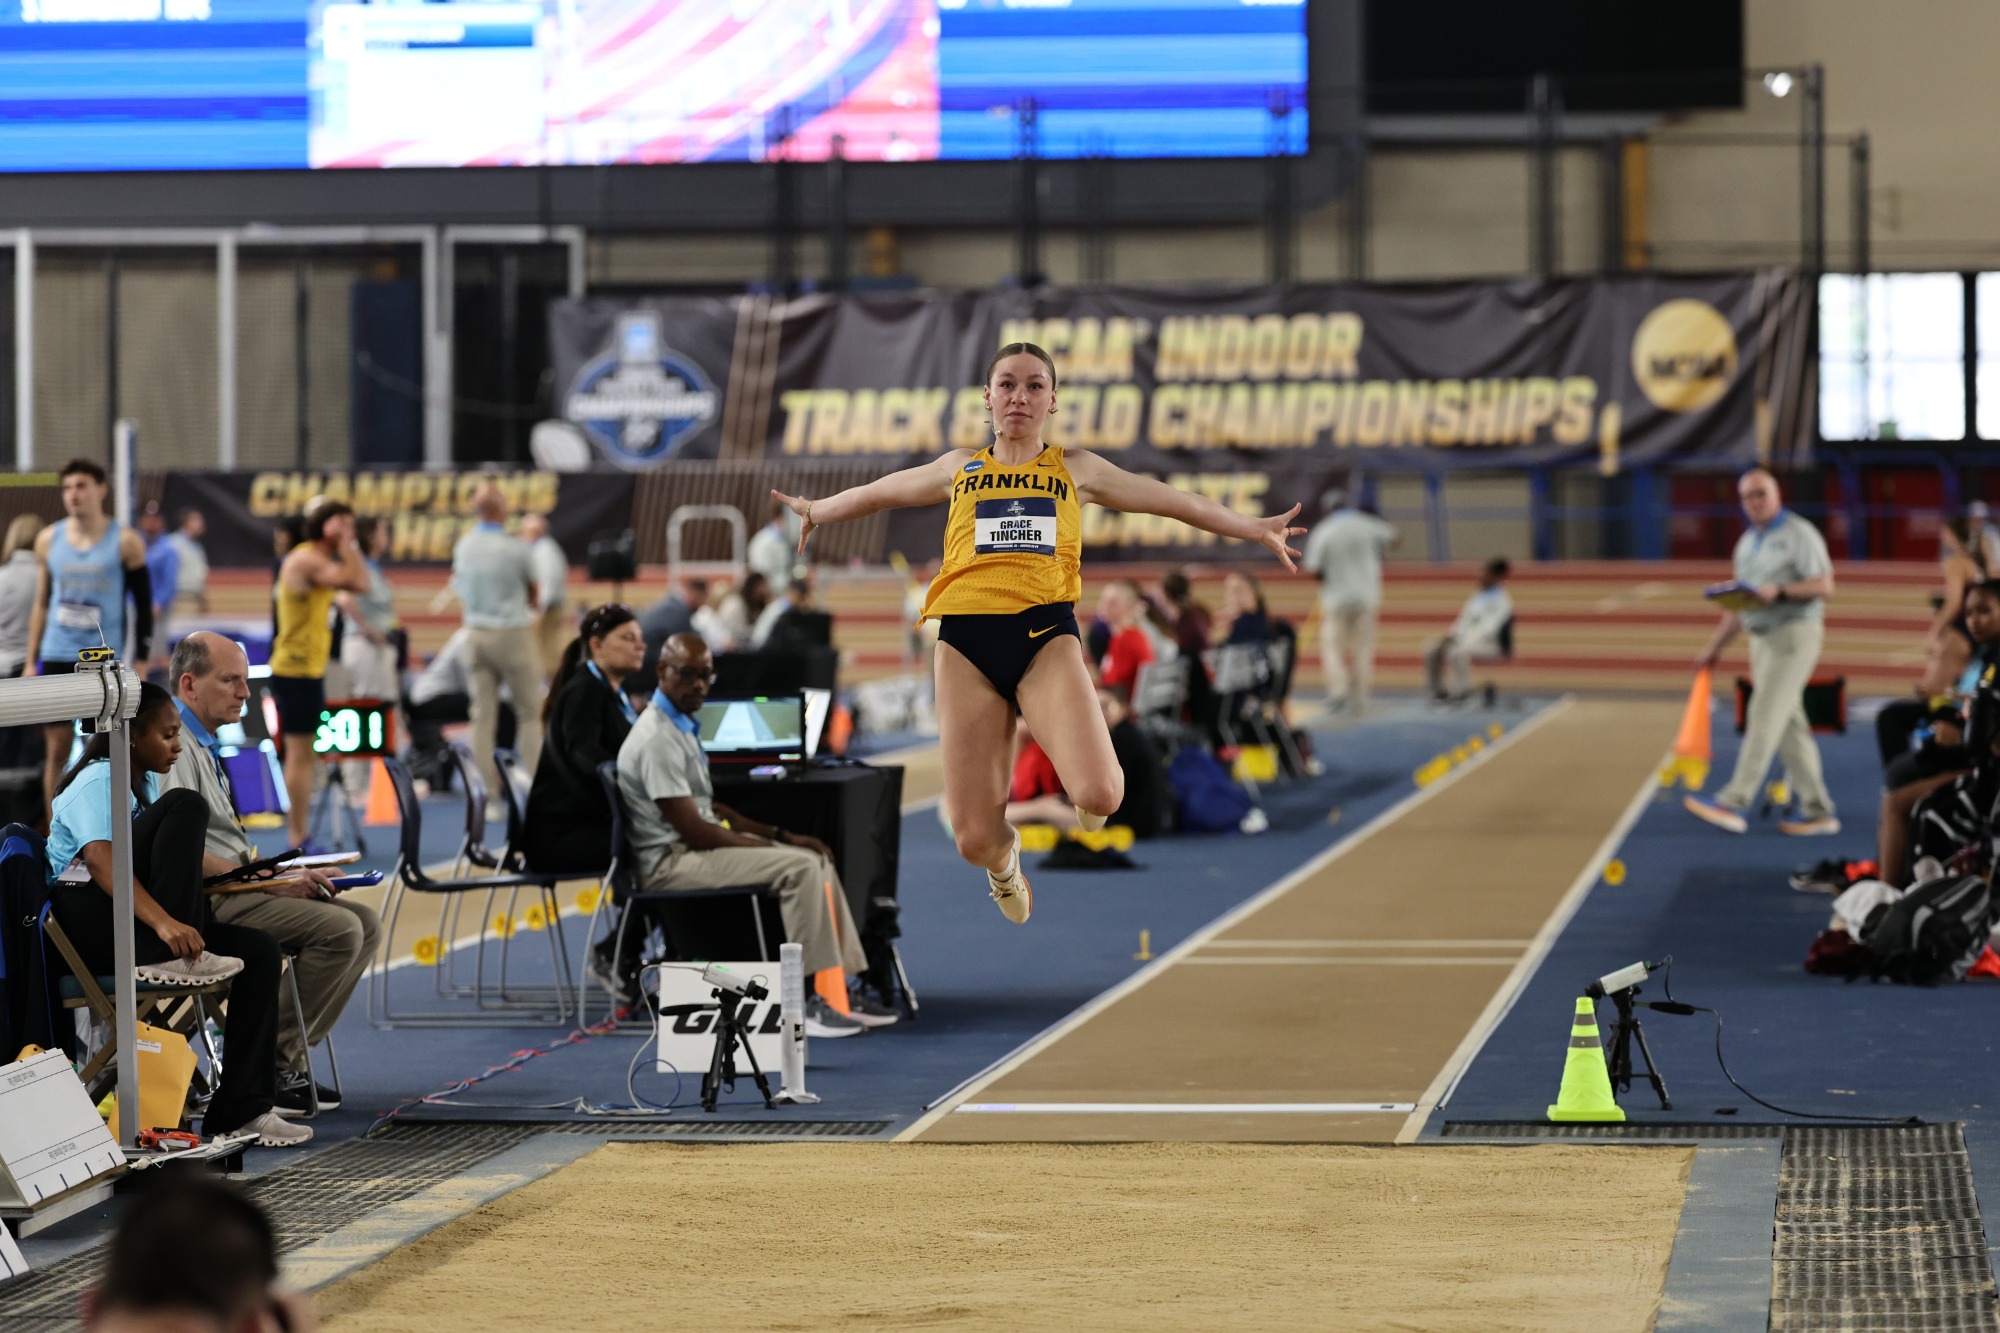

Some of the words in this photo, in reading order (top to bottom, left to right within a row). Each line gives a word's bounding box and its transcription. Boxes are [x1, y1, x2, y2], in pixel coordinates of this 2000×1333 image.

[1154, 312, 1364, 383] INDOOR
[779, 387, 948, 454] TRACK
[1148, 375, 1597, 450] CHAMPIONSHIPS
[953, 473, 1069, 503] FRANKLIN
[990, 529, 1042, 542] TINCHER
[1000, 519, 1032, 530] GRACE
[673, 1003, 781, 1034] GLL
